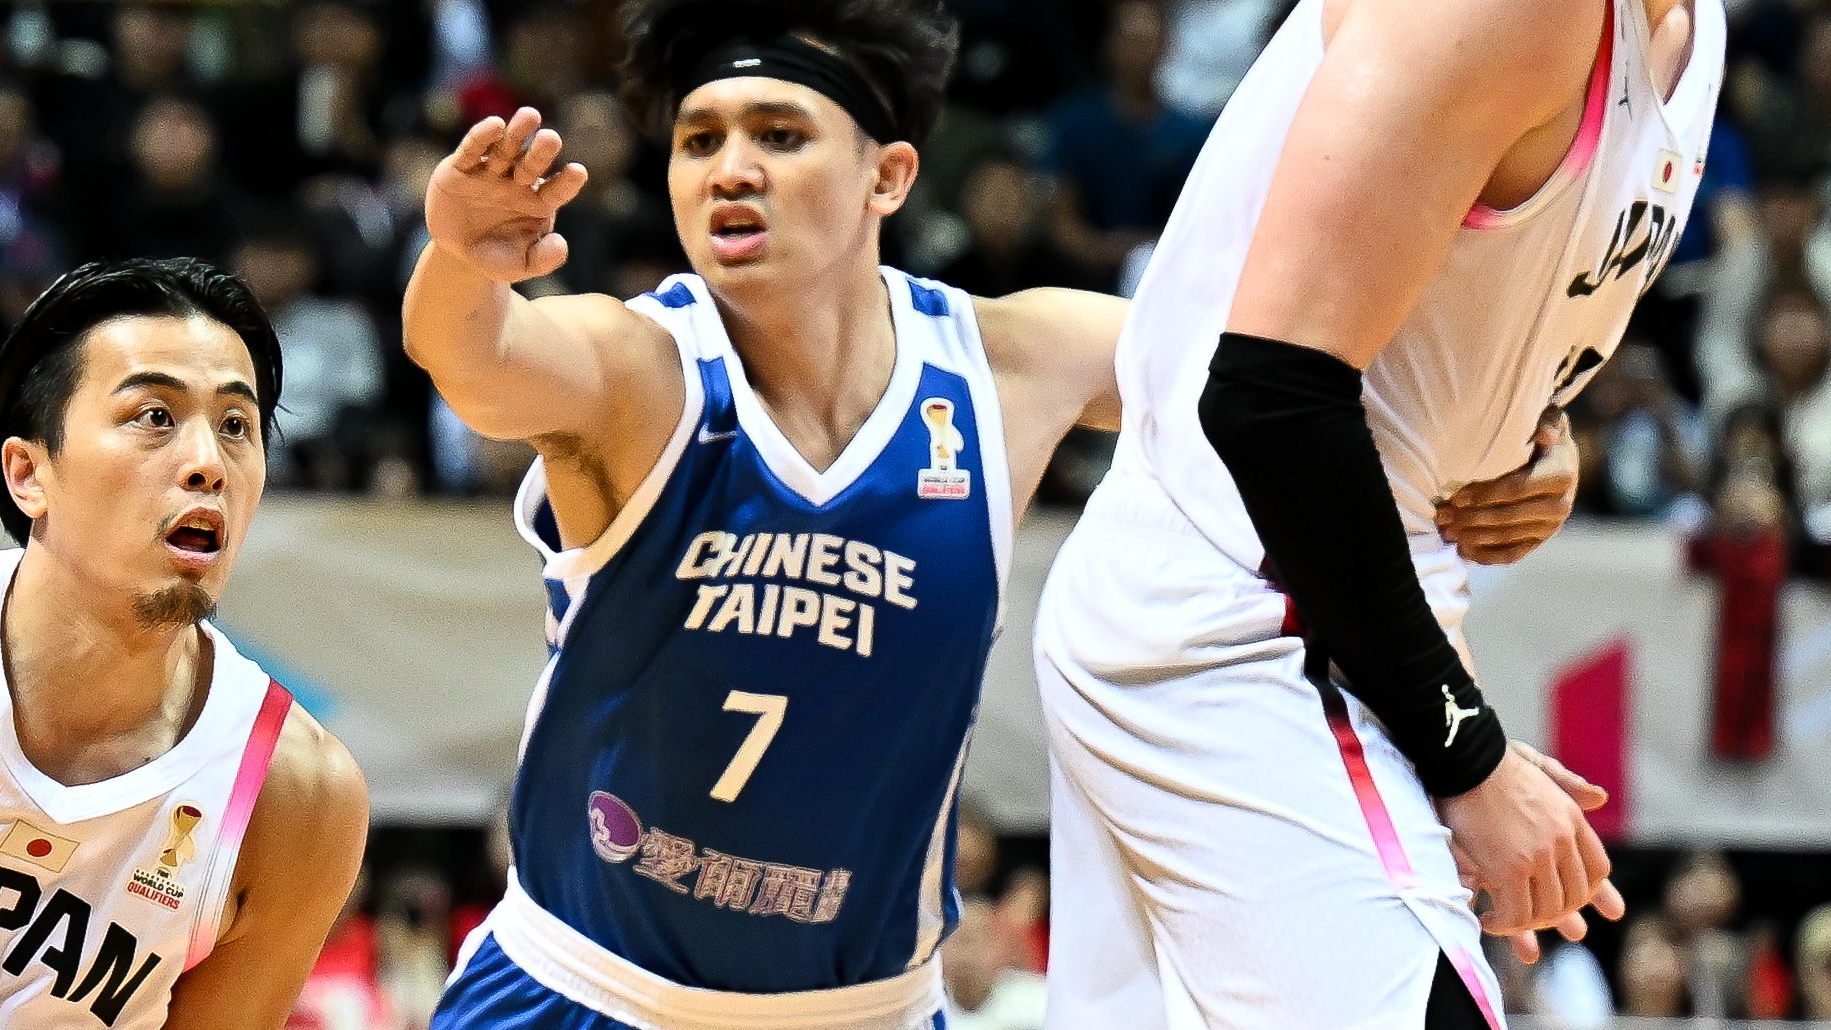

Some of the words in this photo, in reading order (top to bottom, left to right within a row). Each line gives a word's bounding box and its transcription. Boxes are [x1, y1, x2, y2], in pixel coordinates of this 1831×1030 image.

[675, 530, 918, 609] CHINESE
[683, 583, 875, 658] TAIPEI
[709, 689, 789, 803] 7
[127, 882, 180, 909] QUALIFIERS
[133, 873, 164, 891] WORLD
[165, 886, 184, 898] CUP
